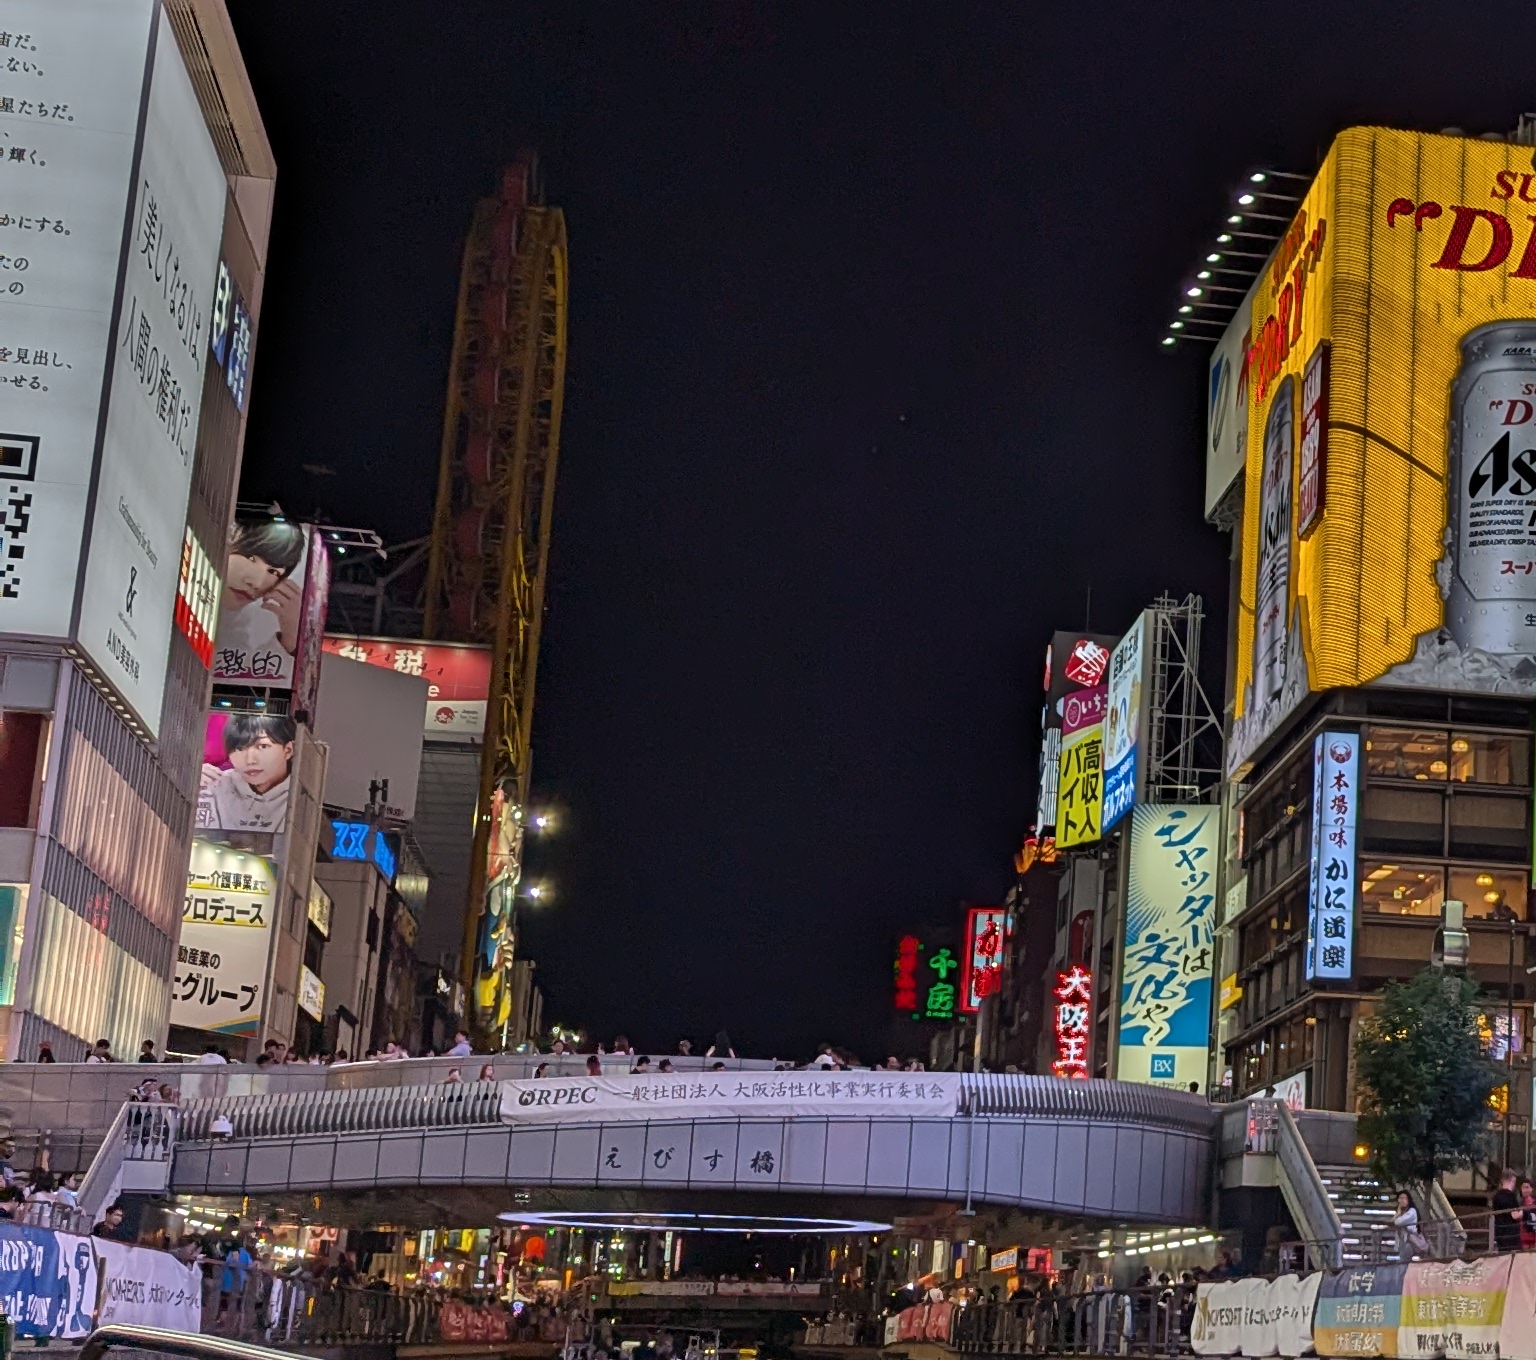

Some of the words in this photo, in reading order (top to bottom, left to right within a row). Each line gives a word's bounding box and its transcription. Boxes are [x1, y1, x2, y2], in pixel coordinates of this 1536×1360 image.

[1062, 743, 1084, 843] バイト
[1078, 739, 1103, 839] 高収入
[1329, 770, 1349, 849] 本場の味
[1322, 857, 1348, 969] かに道楽
[612, 1082, 727, 1101] 一般社団法人
[734, 1081, 945, 1100] 大阪活性化事業実行委員会
[1153, 1058, 1173, 1073] BX
[605, 1146, 775, 1175] えびす橋
